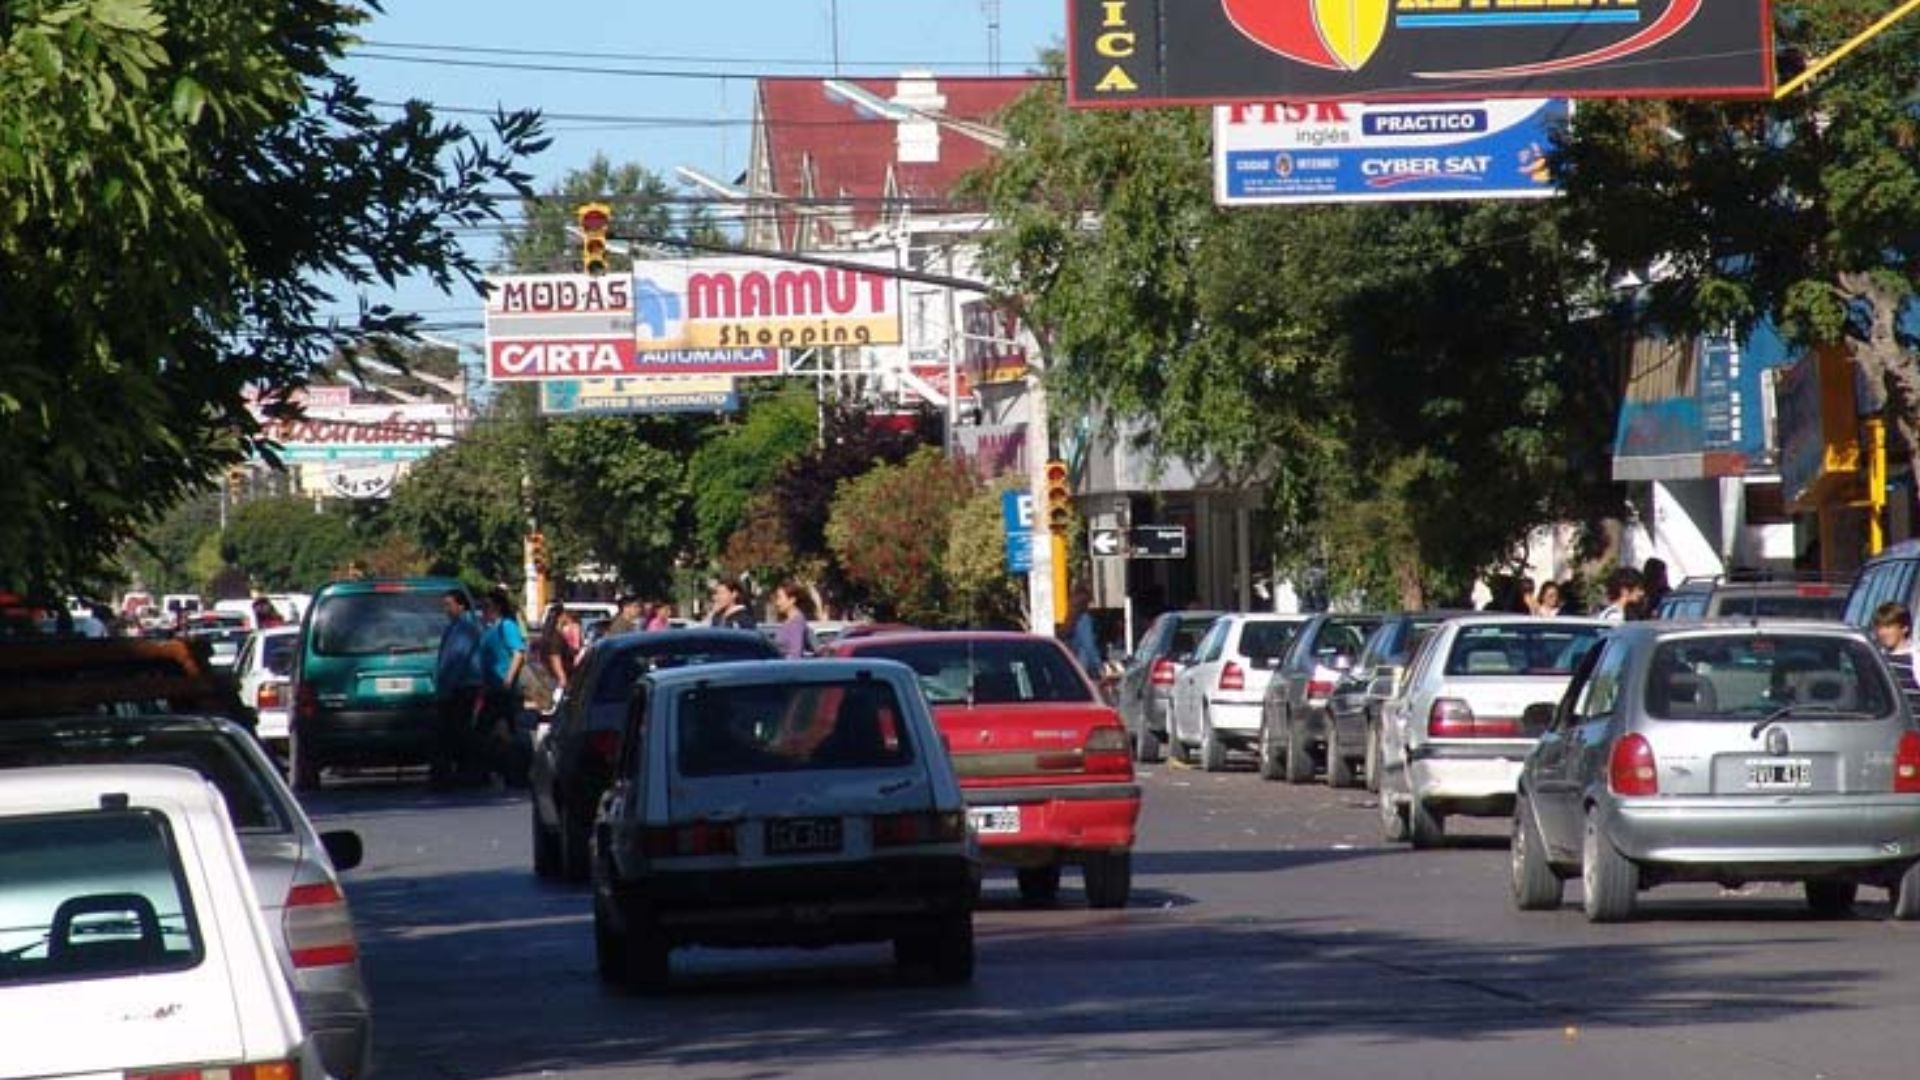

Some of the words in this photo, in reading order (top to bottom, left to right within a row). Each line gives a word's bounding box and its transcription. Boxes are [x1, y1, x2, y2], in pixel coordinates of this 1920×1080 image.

[1376, 114, 1475, 132] PRACTICO
[1361, 158, 1440, 175] CYBER
[1444, 156, 1493, 172] SAT
[502, 281, 627, 312] MODAS
[688, 267, 893, 318] MAMUT
[719, 320, 870, 348] Shopping
[500, 344, 624, 373] CARTA
